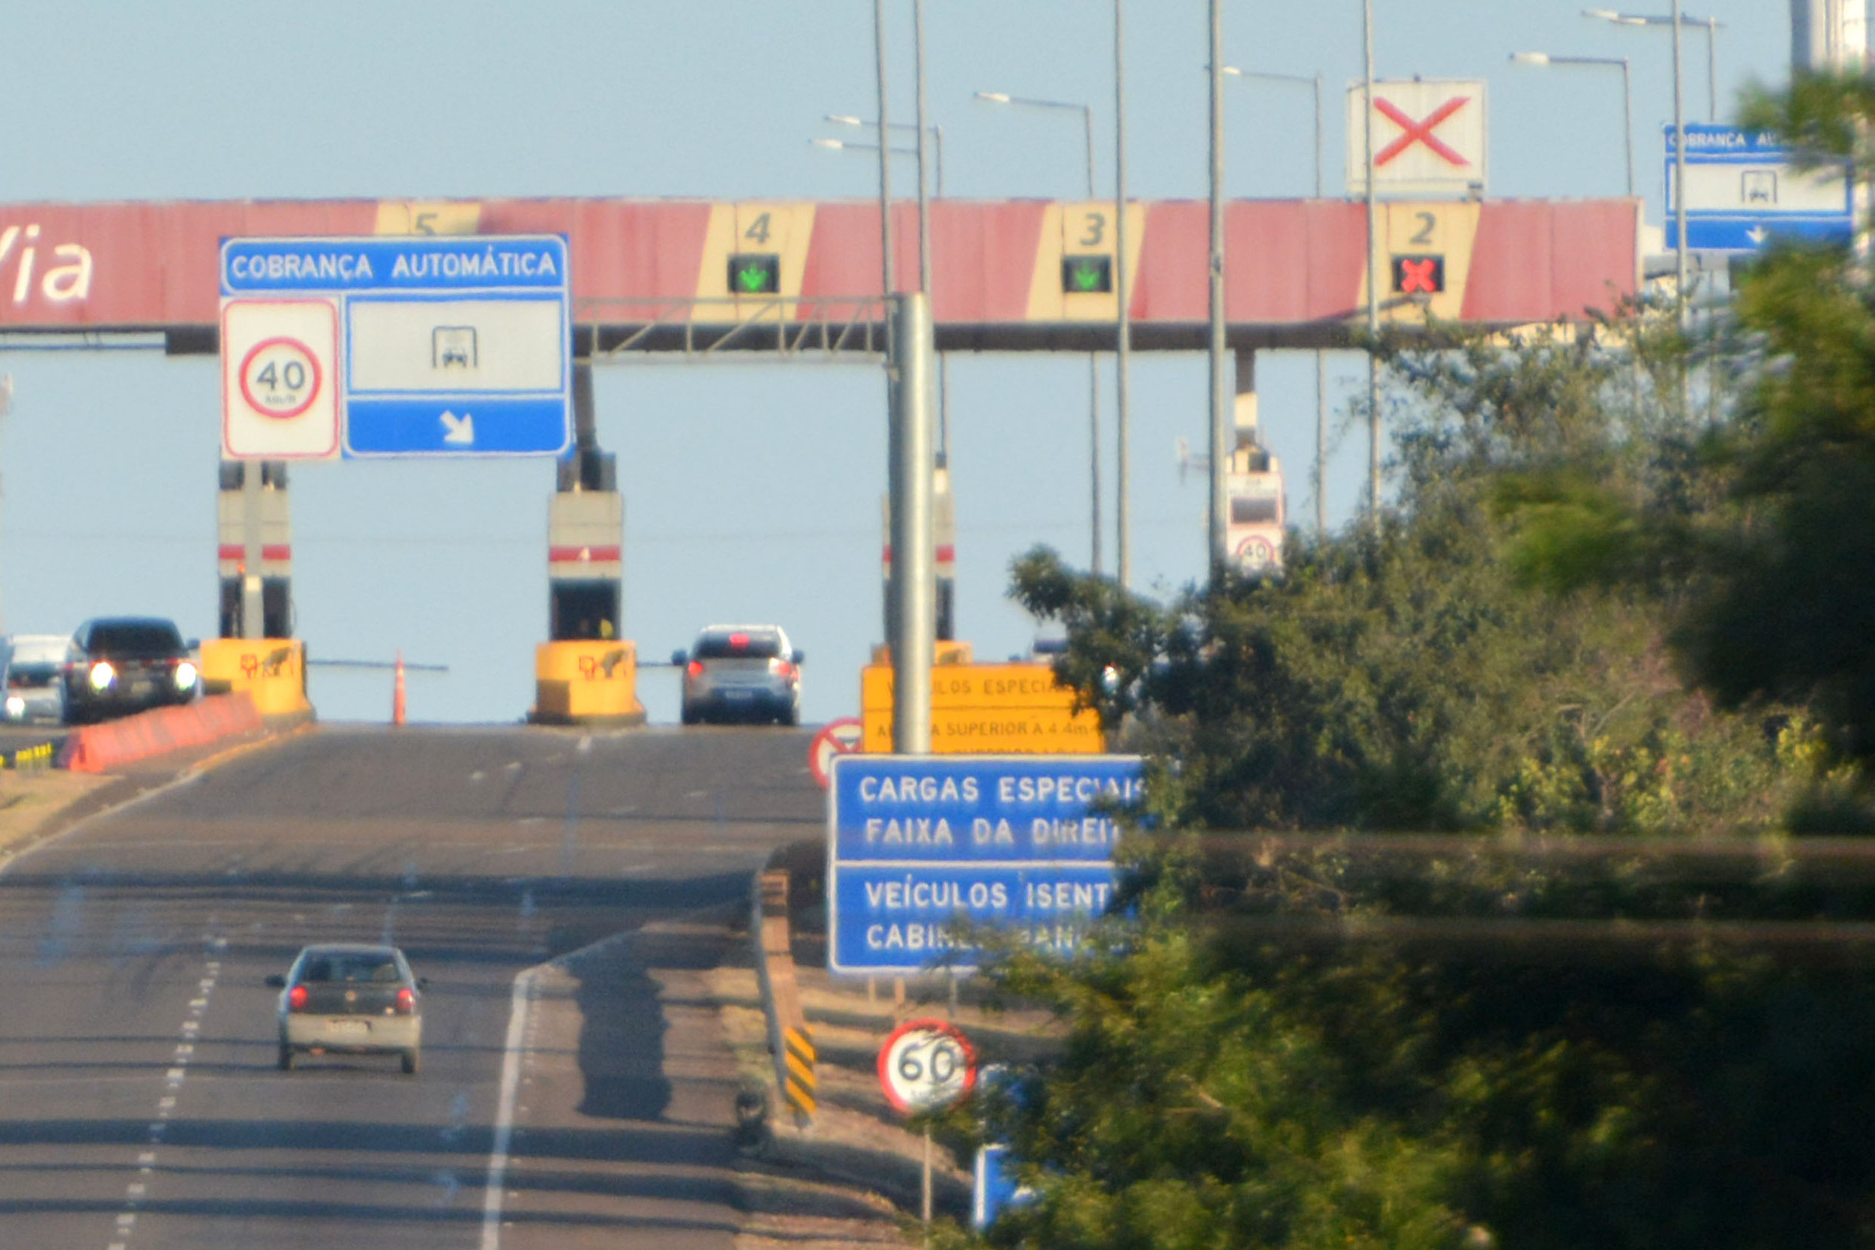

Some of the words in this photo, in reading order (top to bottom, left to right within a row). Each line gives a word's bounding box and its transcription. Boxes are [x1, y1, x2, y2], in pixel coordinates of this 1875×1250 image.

[745, 212, 772, 244] 4
[1079, 212, 1106, 246] 3
[1408, 211, 1437, 245] 2
[231, 254, 373, 280] COBRANÇA
[392, 245, 558, 279] AUTOMÁTICA
[256, 360, 306, 391] 40
[947, 721, 1028, 737] SUPERIOR
[860, 776, 979, 802] CARGAS
[866, 817, 953, 845] FAIXA
[973, 817, 1015, 844] DA
[865, 873, 1008, 908] VEÍCULOS
[897, 1042, 956, 1082] 60
